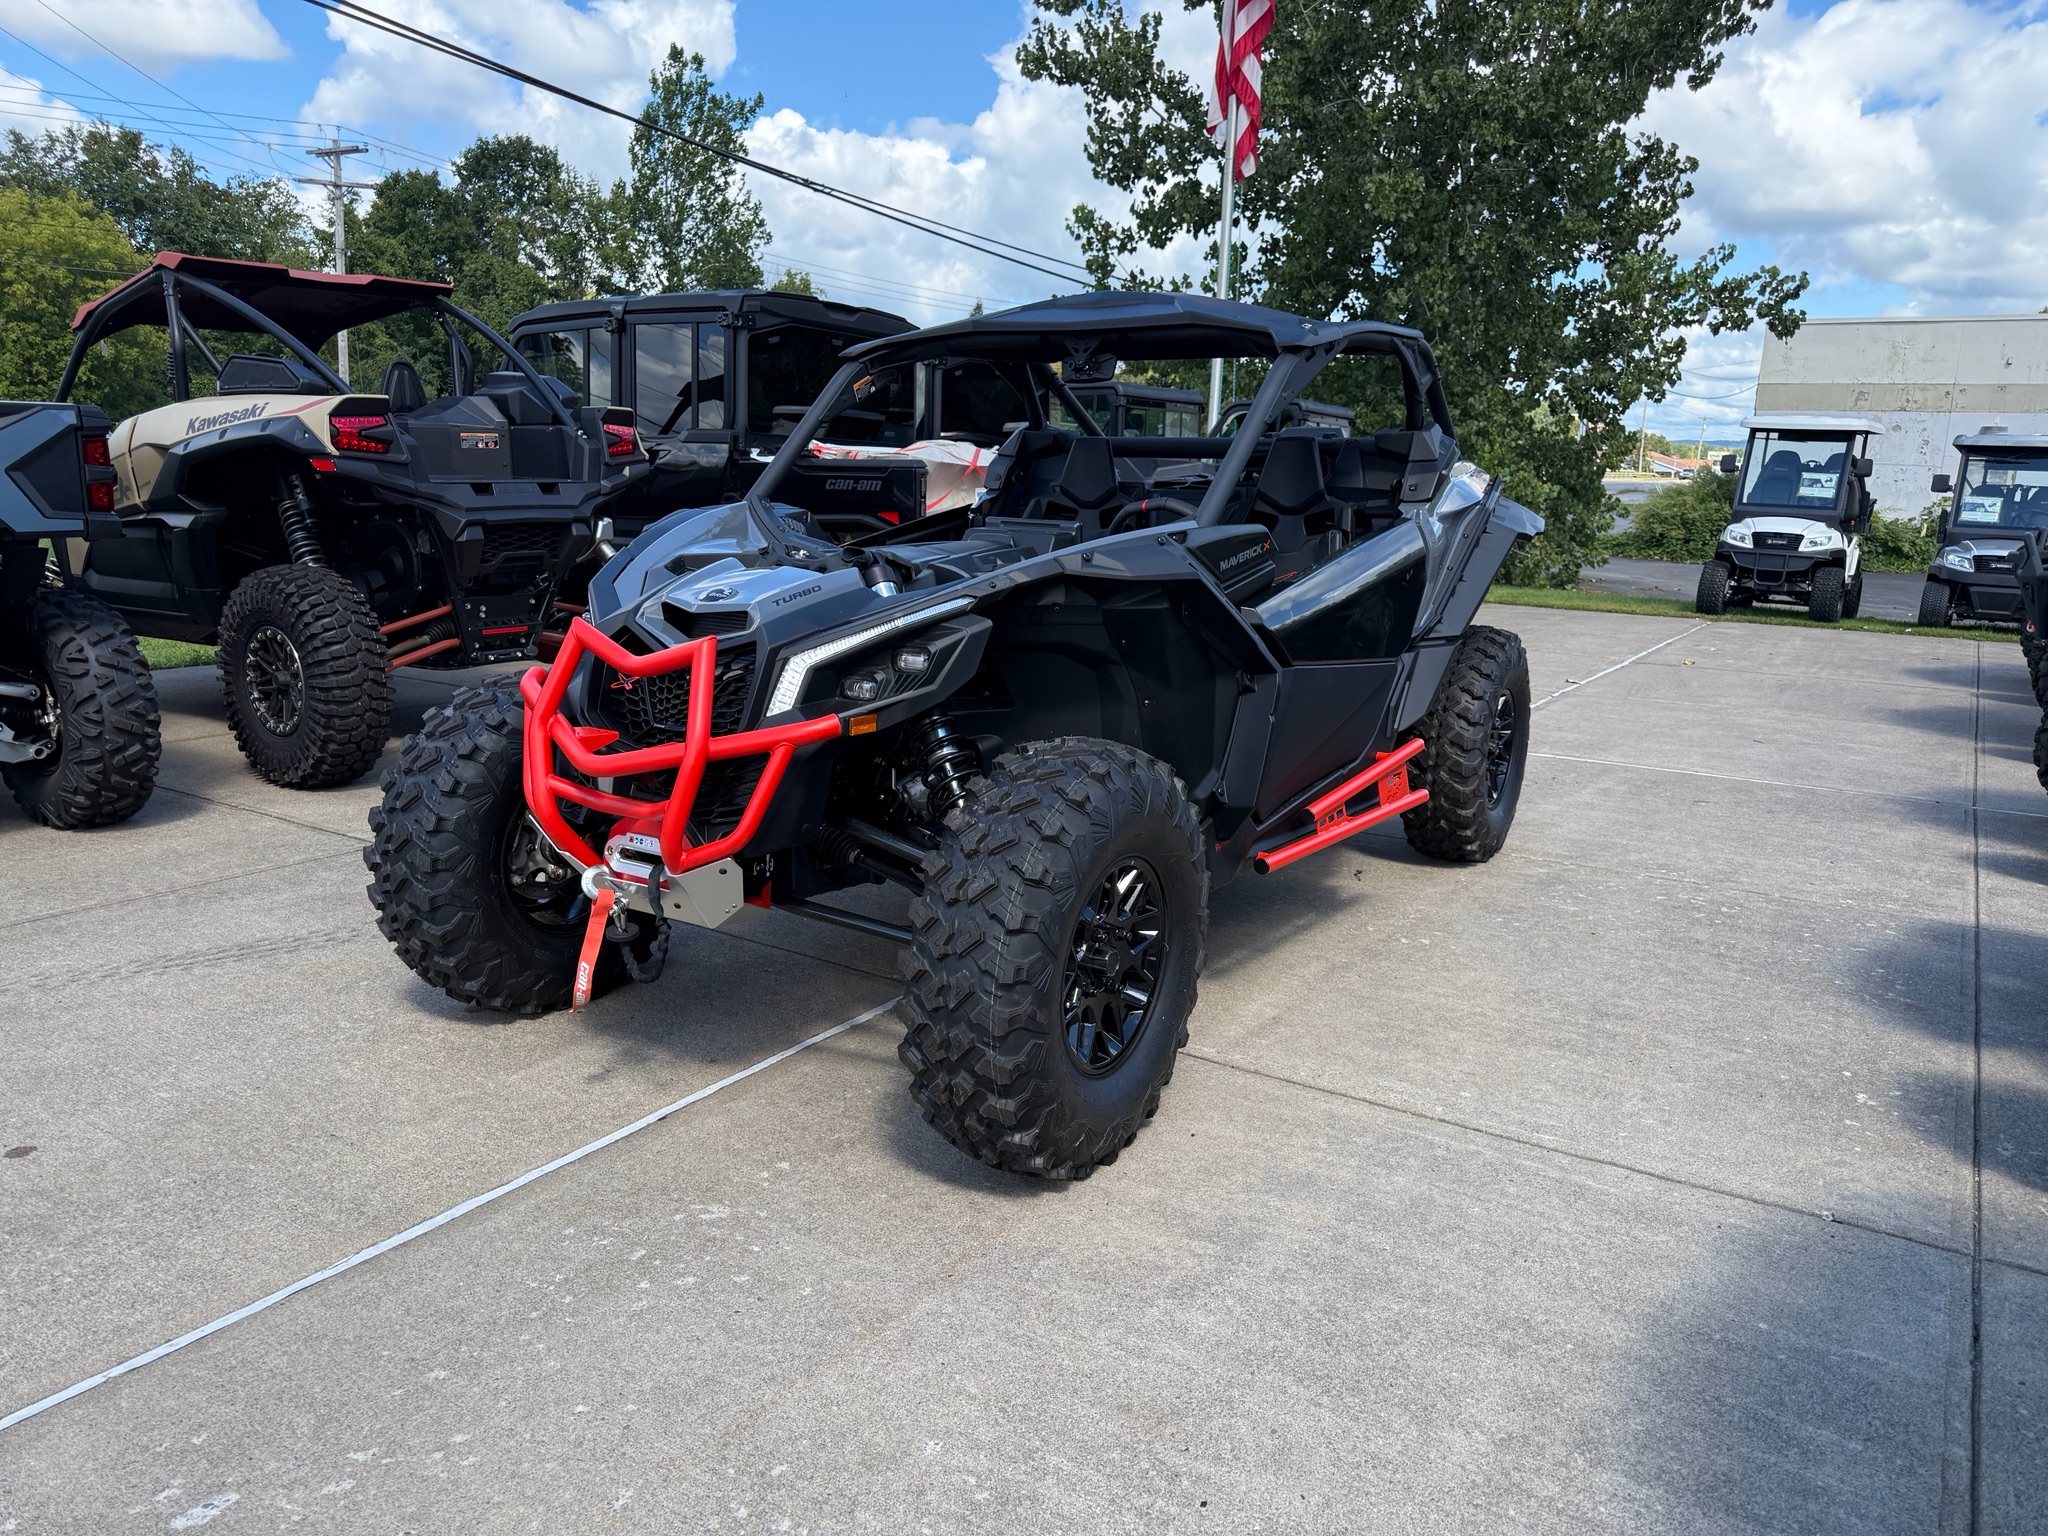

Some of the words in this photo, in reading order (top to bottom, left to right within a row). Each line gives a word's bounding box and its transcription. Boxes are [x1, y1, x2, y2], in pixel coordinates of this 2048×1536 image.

[185, 402, 269, 436] Kawasaki
[825, 479, 882, 491] can-am
[1220, 543, 1262, 571] MAVERICK
[771, 584, 822, 607] TURBO
